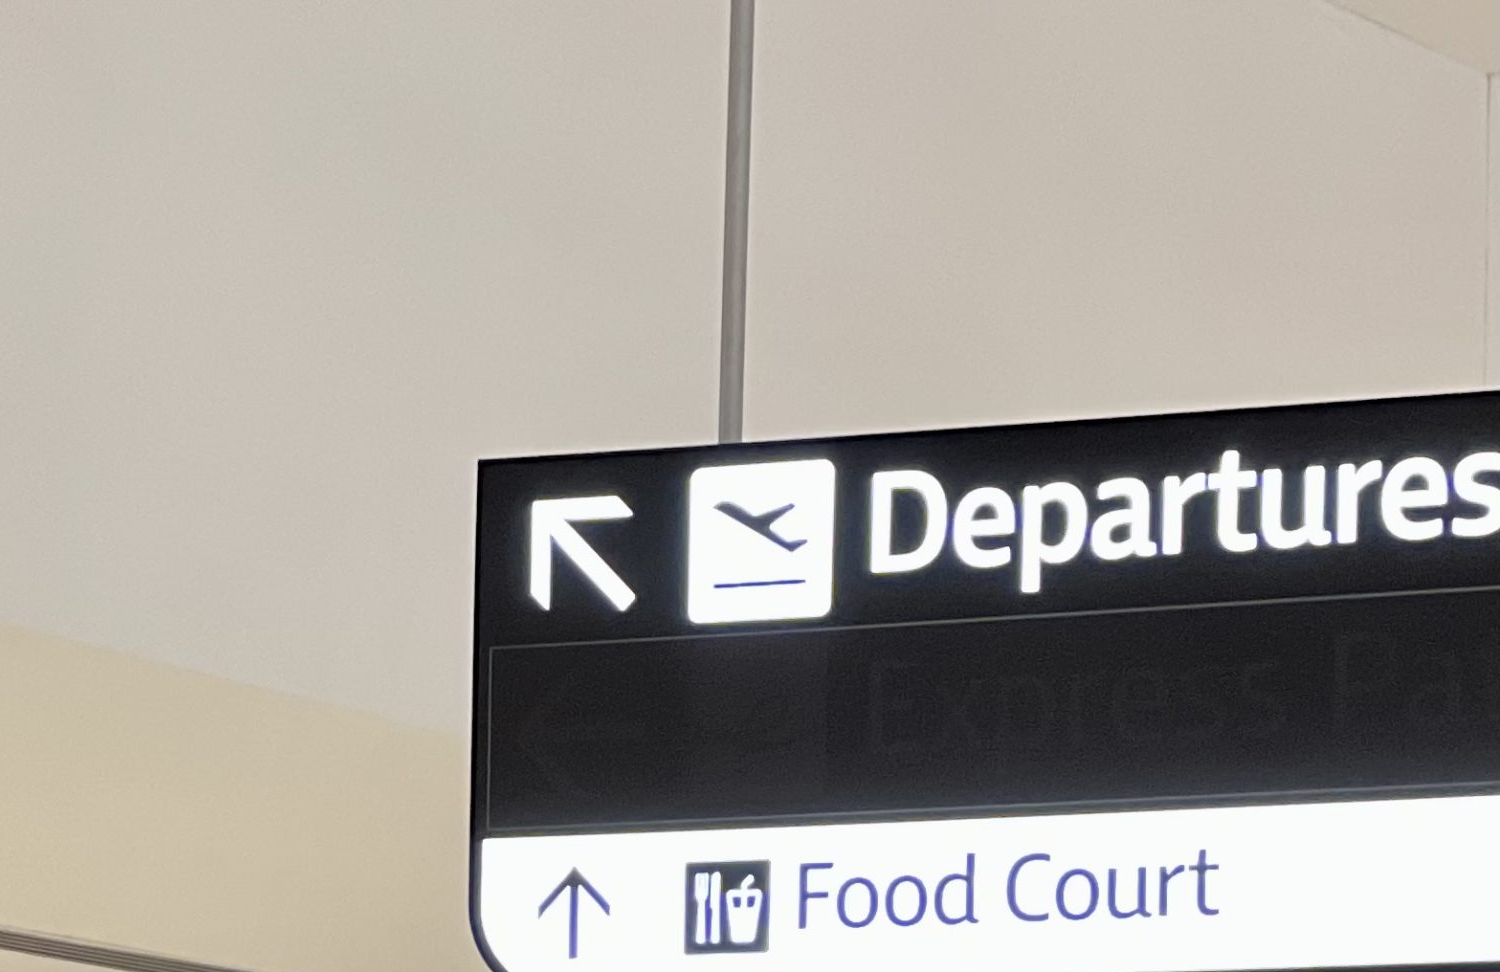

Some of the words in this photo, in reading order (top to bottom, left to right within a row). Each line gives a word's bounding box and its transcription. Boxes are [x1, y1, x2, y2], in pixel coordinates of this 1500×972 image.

[869, 449, 1500, 594] Departures
[798, 852, 980, 930] Food
[1006, 849, 1220, 922] Court
